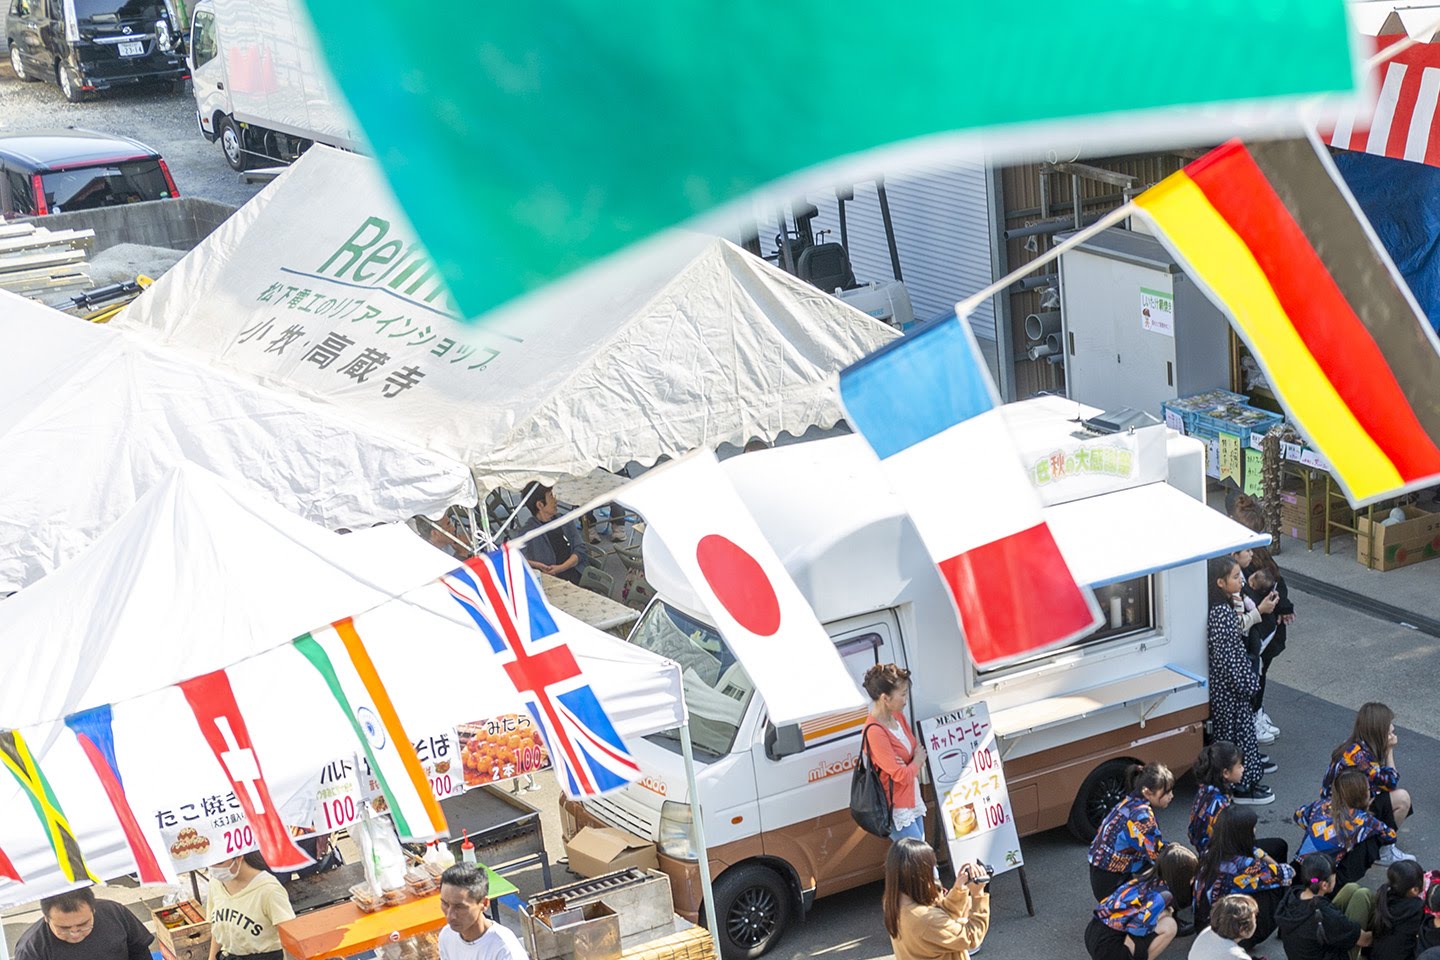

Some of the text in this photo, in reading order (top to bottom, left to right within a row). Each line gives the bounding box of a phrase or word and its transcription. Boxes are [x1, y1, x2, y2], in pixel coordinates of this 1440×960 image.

[936, 708, 965, 726] MENU
[930, 721, 989, 751] ホットコーヒー
[513, 745, 542, 773] 100
[943, 774, 1000, 806] コーンスープ
[323, 794, 355, 829] 100
[223, 824, 253, 854] 200
